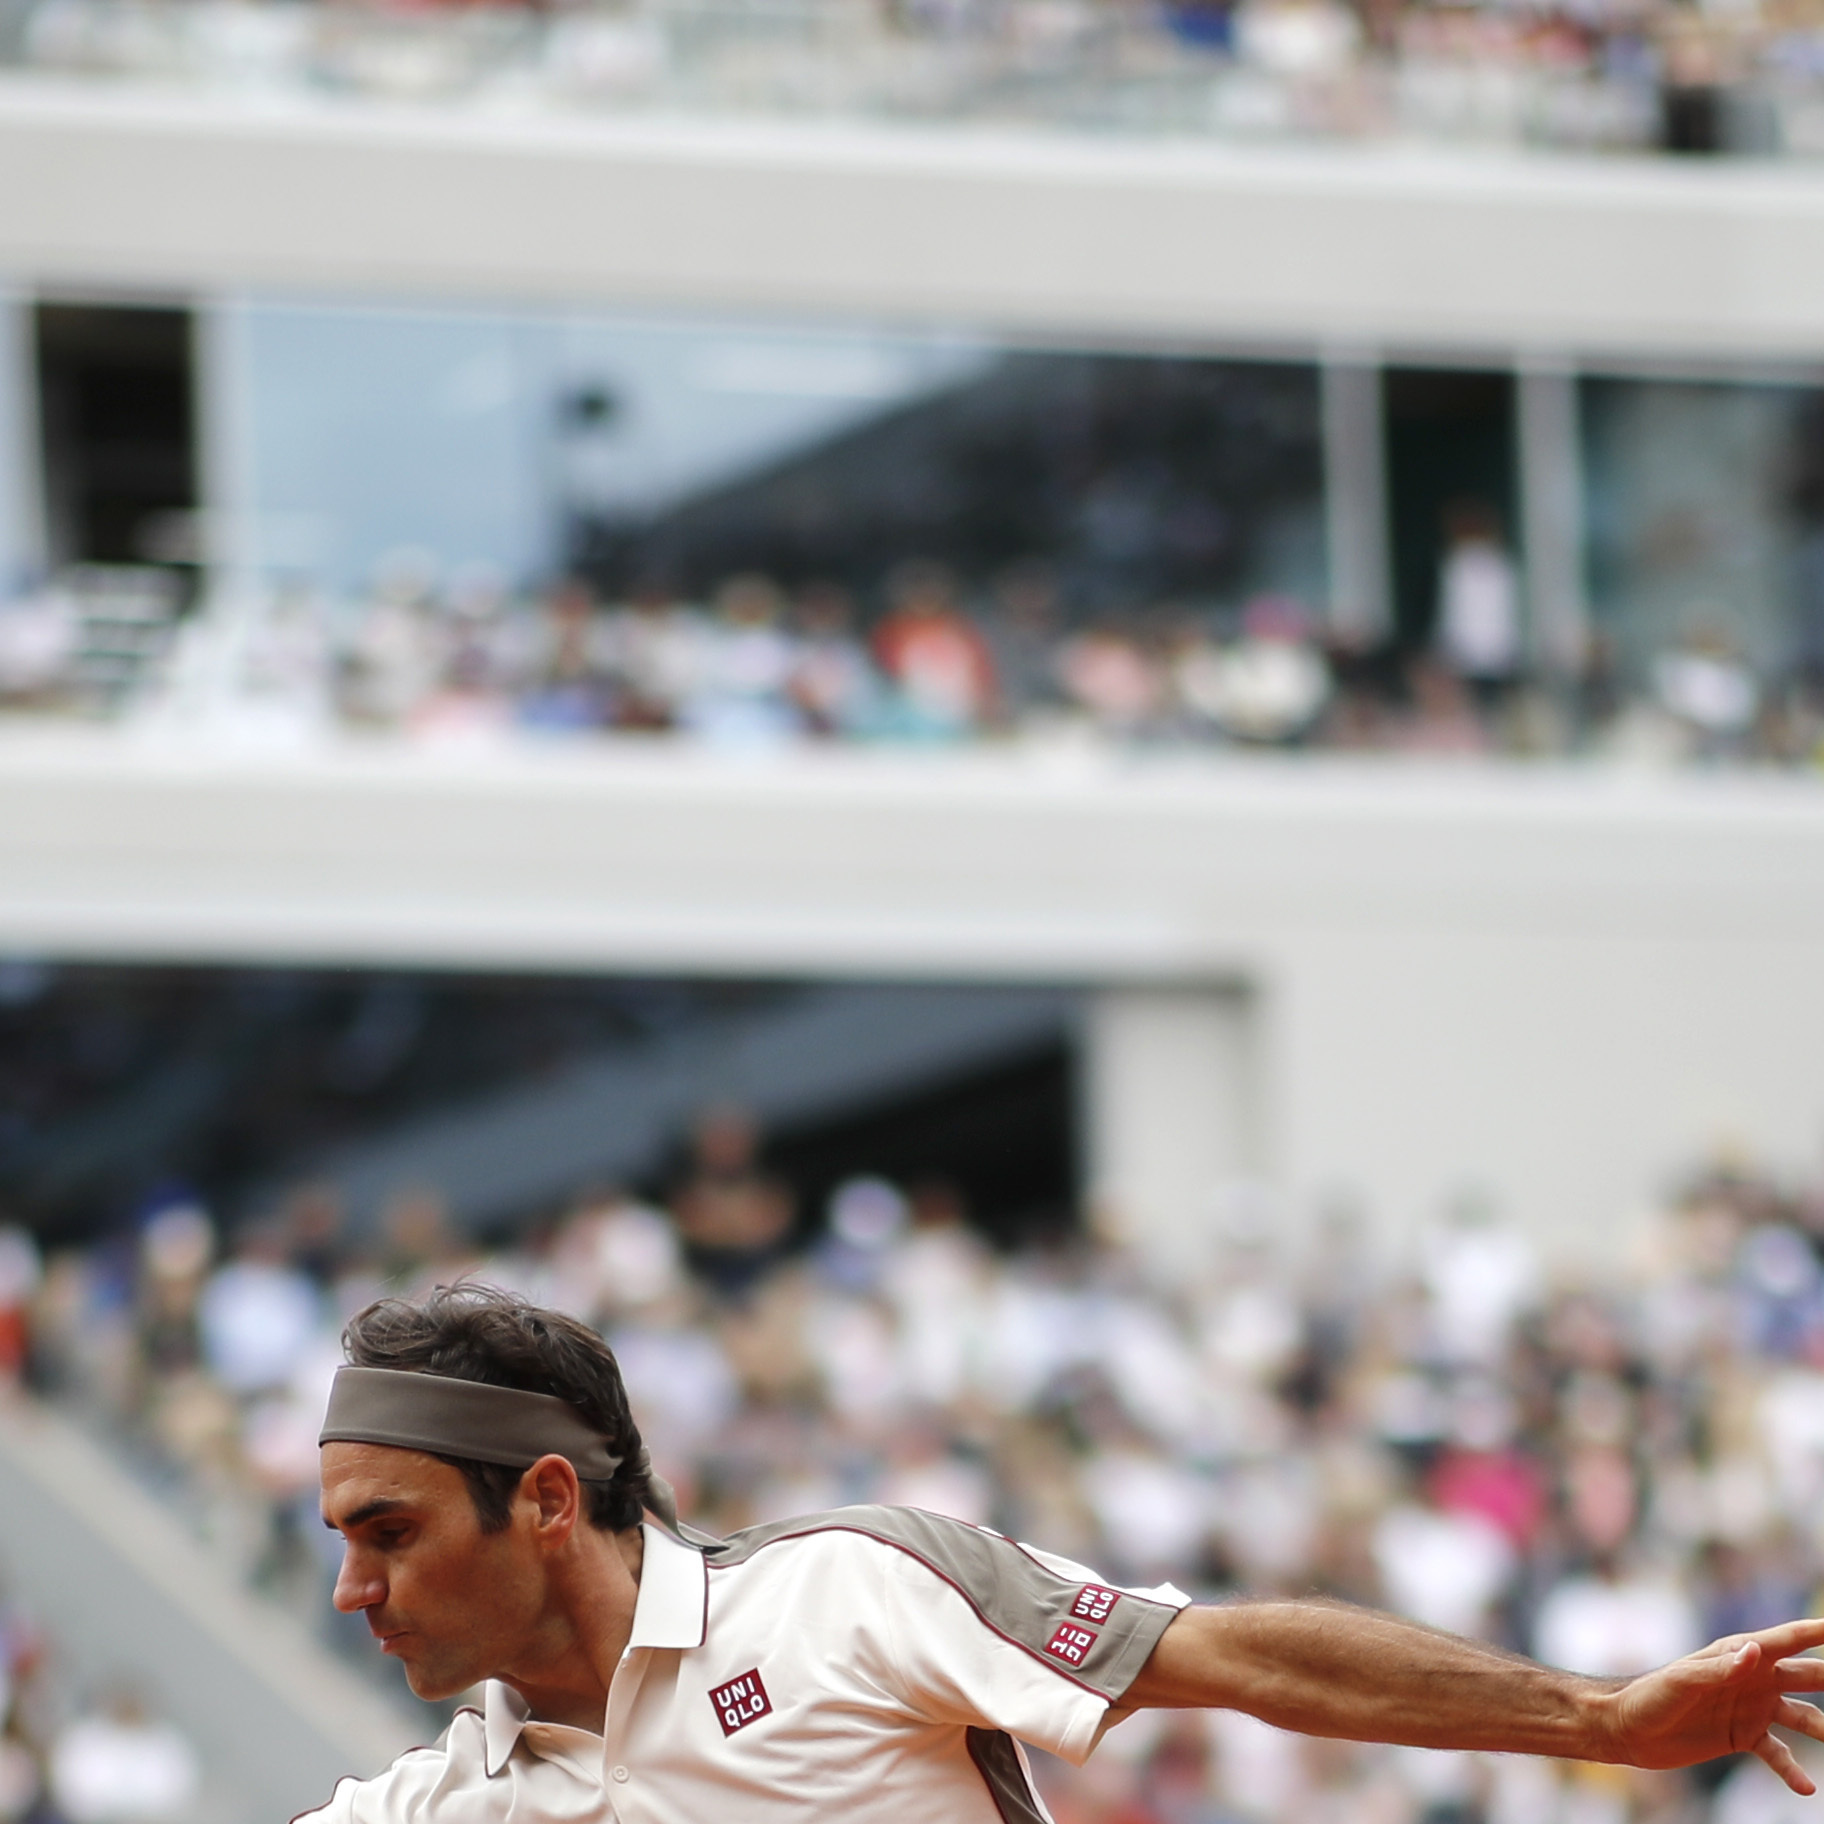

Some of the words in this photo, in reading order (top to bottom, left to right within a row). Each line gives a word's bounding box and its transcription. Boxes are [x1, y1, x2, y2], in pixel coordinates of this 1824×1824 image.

[1075, 1588, 1099, 1615] UNI
[1090, 1592, 1114, 1619] QLO
[716, 1677, 755, 1708] UNI
[724, 1694, 765, 1727] QLO
